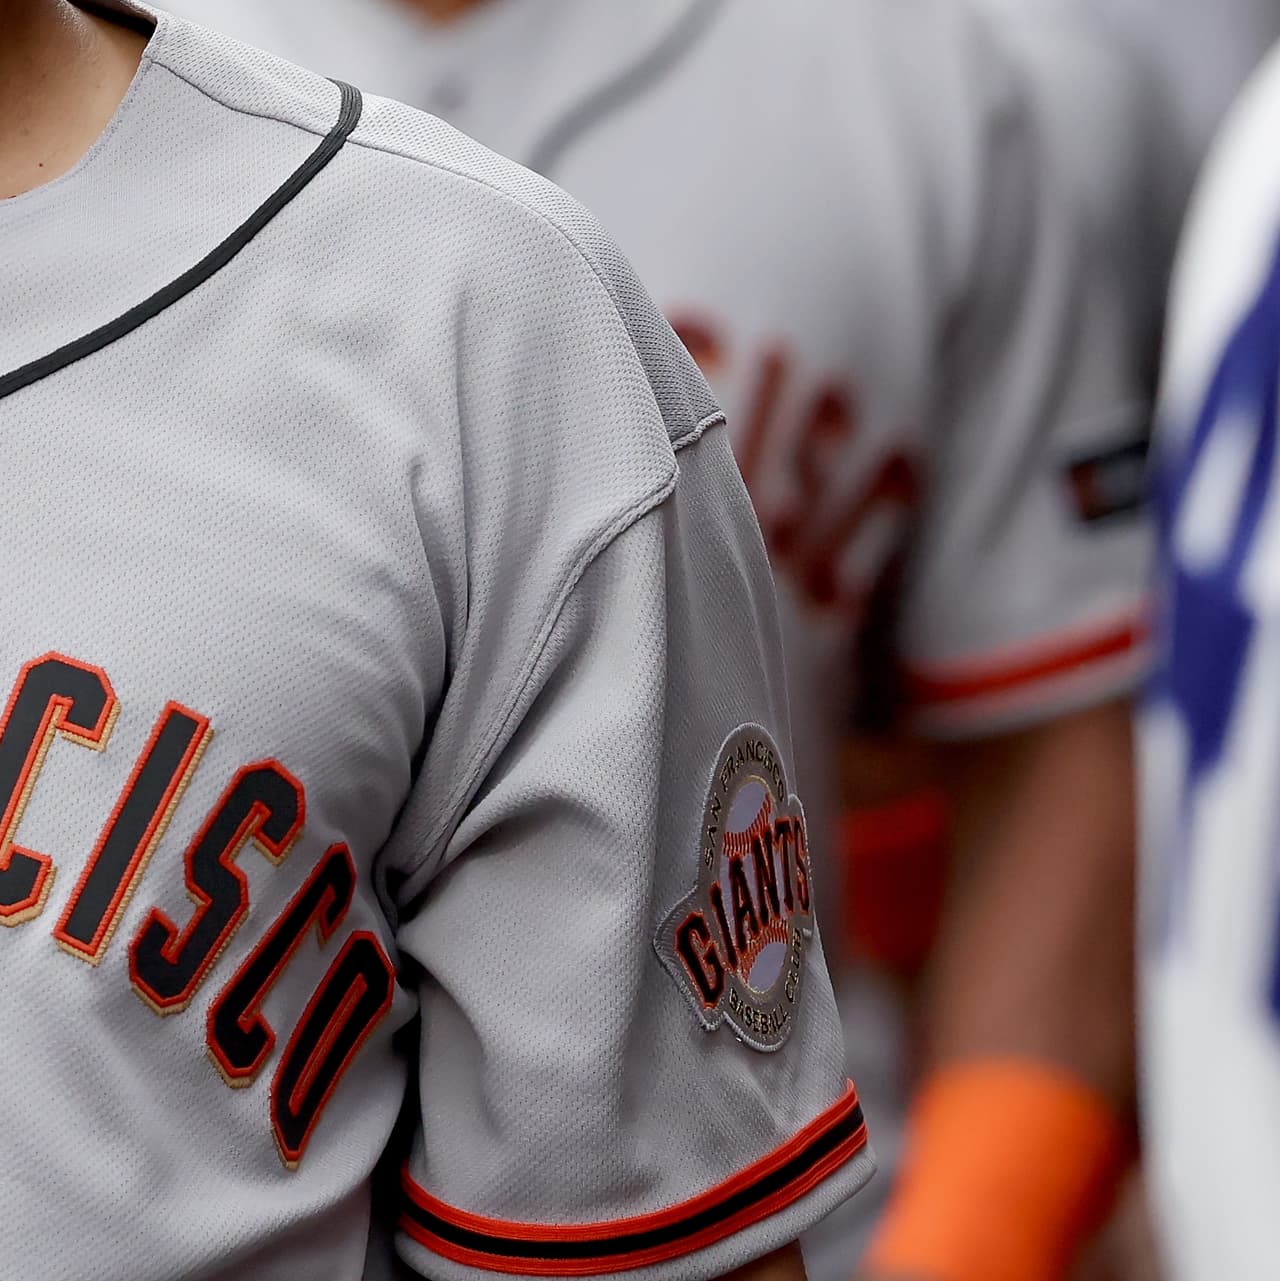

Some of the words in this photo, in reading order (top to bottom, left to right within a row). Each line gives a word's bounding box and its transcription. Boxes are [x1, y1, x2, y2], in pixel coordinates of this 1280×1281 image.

[720, 740, 785, 803] FRANCISCO
[674, 816, 810, 1010] GIANTS
[728, 987, 791, 1036] BASEBALL
